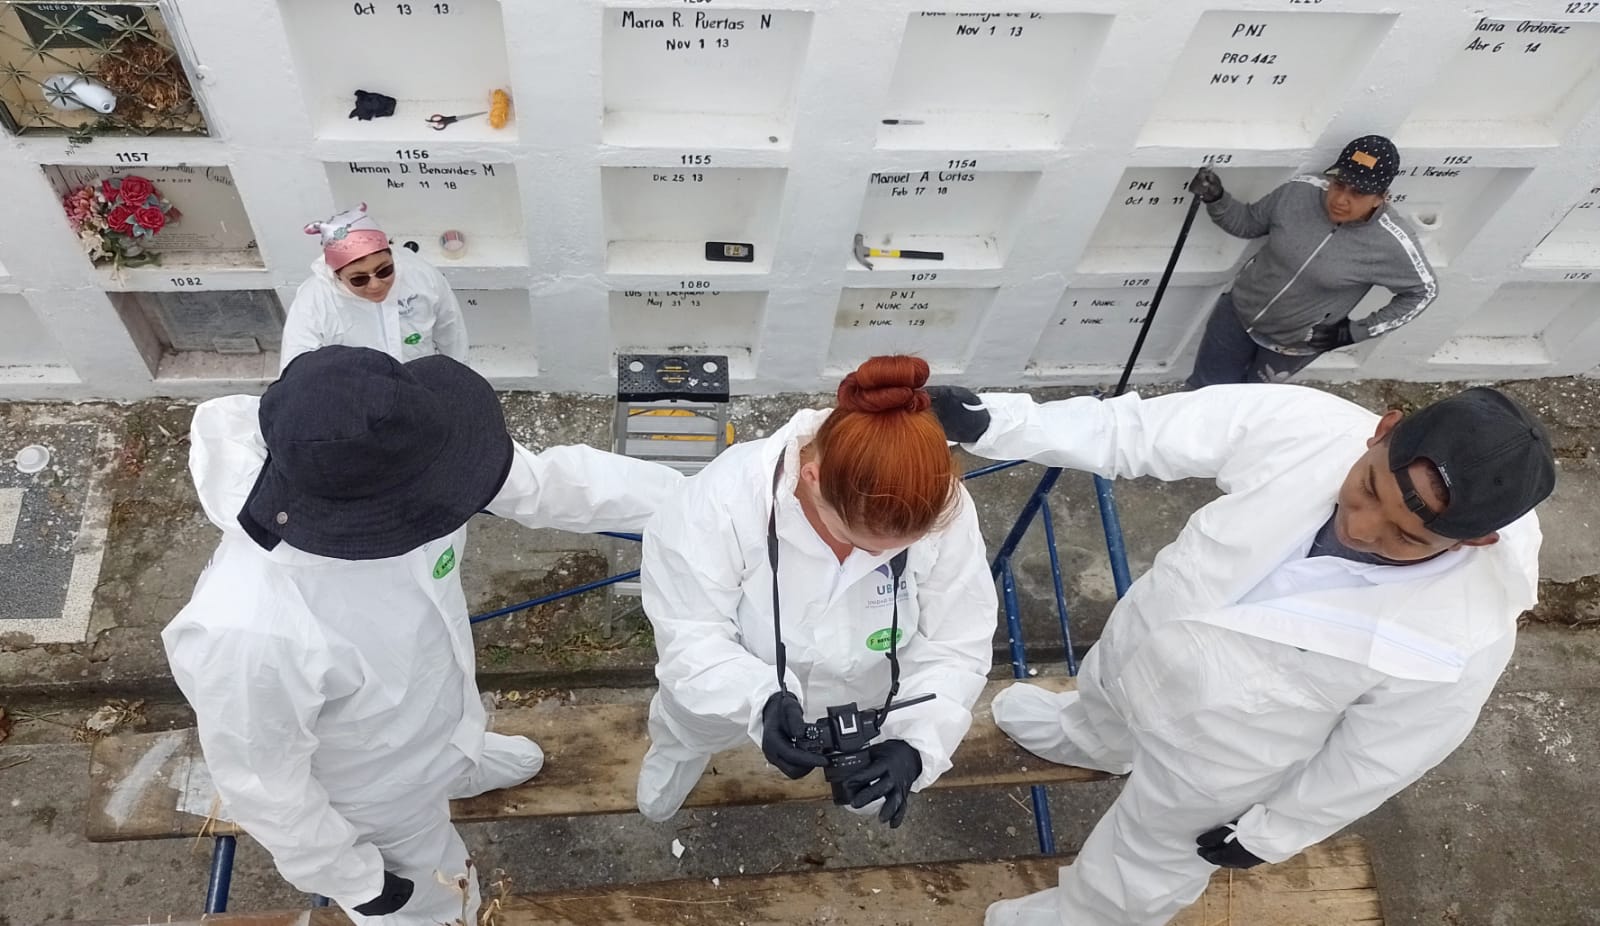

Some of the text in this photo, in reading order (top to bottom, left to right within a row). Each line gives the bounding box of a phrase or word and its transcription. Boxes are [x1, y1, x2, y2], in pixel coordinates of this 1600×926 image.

[354, 2, 449, 15] Oct 13 13
[1565, 2, 1599, 14] 1227
[622, 10, 664, 29] Maria
[760, 13, 772, 30] N
[956, 25, 1023, 37] Nov 1 13
[1231, 23, 1268, 38] PNI
[666, 38, 729, 51] Nov 1 13
[1464, 36, 1541, 53] Abr 6 14
[1246, 74, 1254, 85] 1
[1272, 74, 1287, 85] 13
[116, 152, 149, 163] 1157
[396, 149, 430, 160] 1156
[681, 154, 712, 165] 1155
[1202, 154, 1233, 164] 1153
[419, 162, 477, 176] Benavides
[482, 163, 496, 176] M
[948, 159, 977, 169] 1154
[671, 174, 685, 182] 25
[692, 174, 703, 182] 13
[870, 172, 910, 185] Manuel
[919, 171, 929, 183] A
[914, 187, 926, 195] 17
[1129, 181, 1154, 190] PNI
[170, 277, 203, 287] 1082
[911, 273, 937, 281] 1079
[877, 580, 907, 595] UBD
